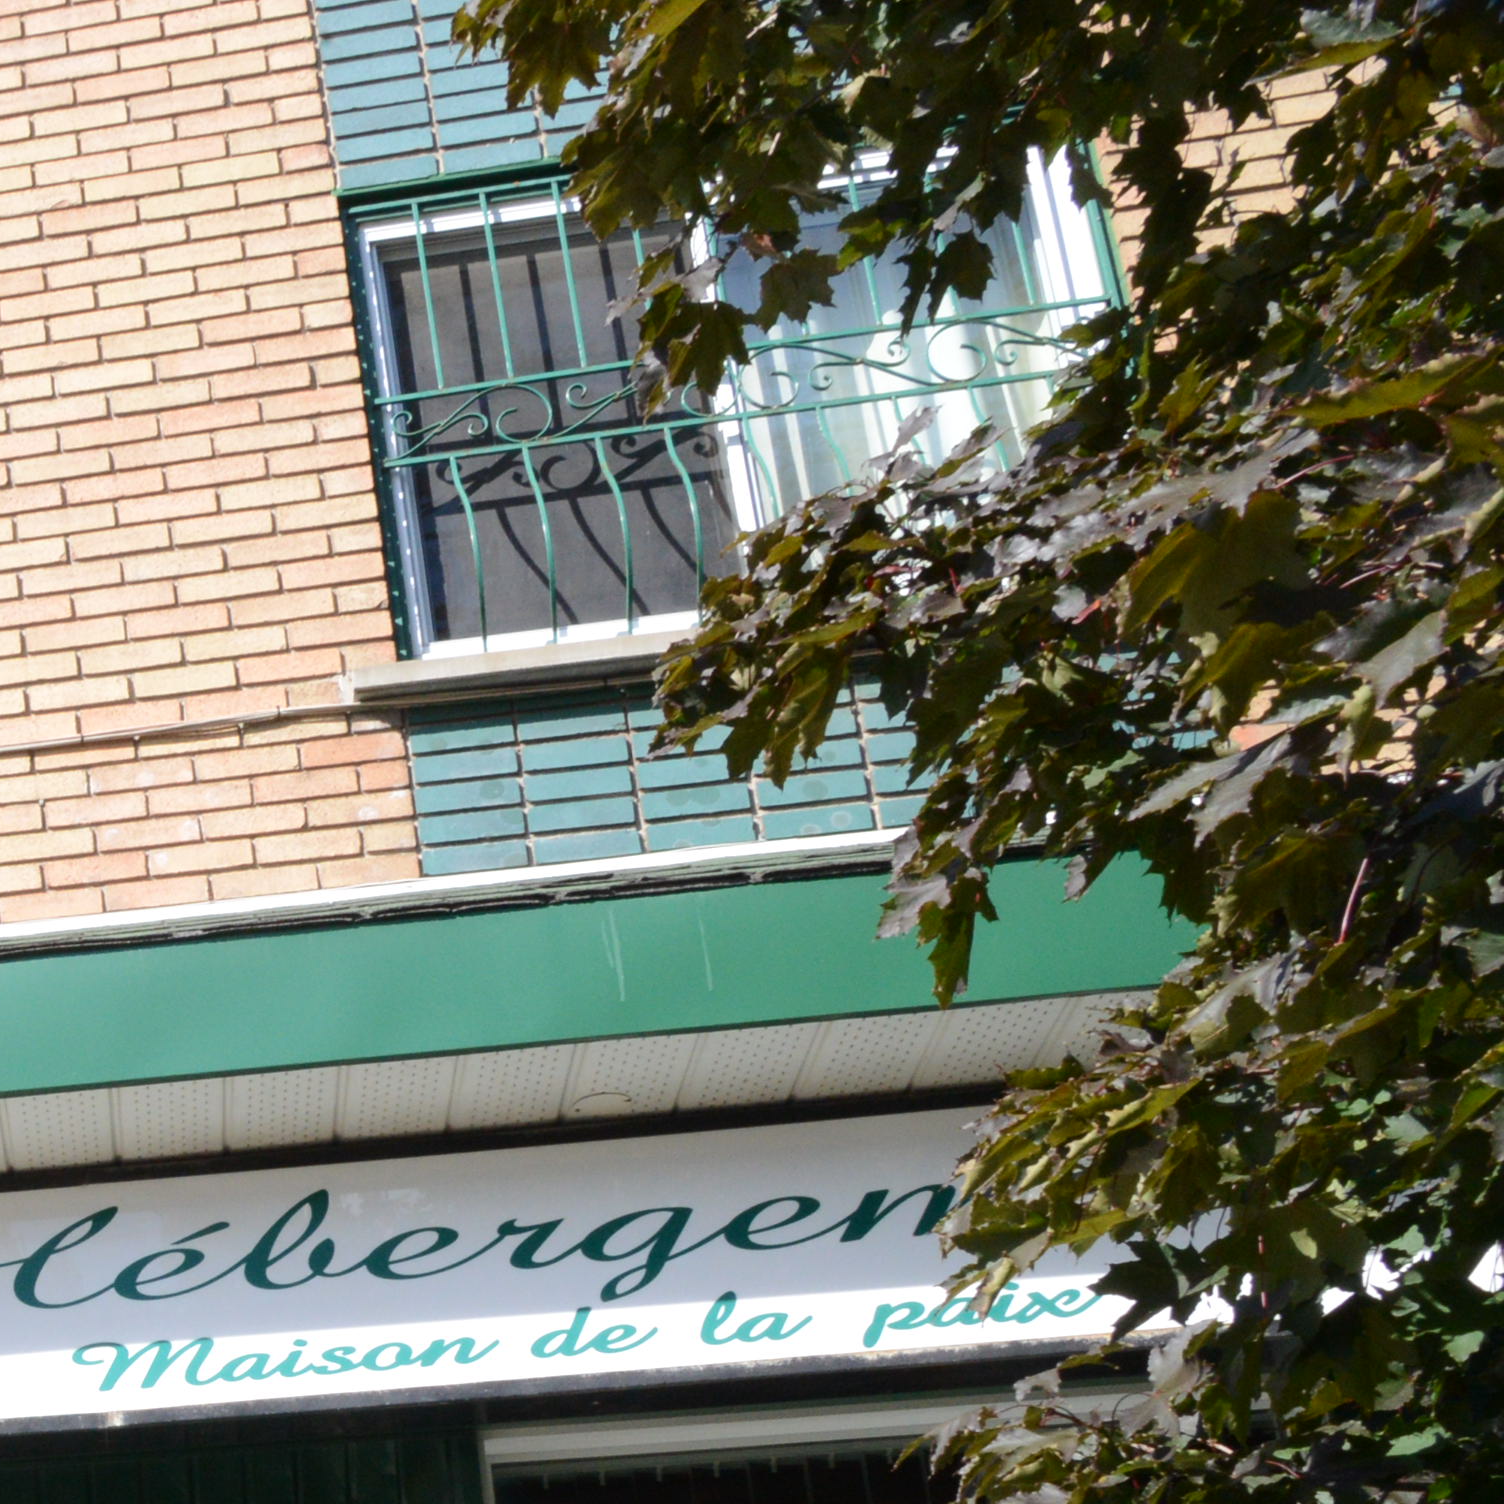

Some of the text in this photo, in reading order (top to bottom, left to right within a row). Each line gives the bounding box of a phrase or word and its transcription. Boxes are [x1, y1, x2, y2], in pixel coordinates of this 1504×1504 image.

[72, 1280, 1104, 1392] Maison de la paix
